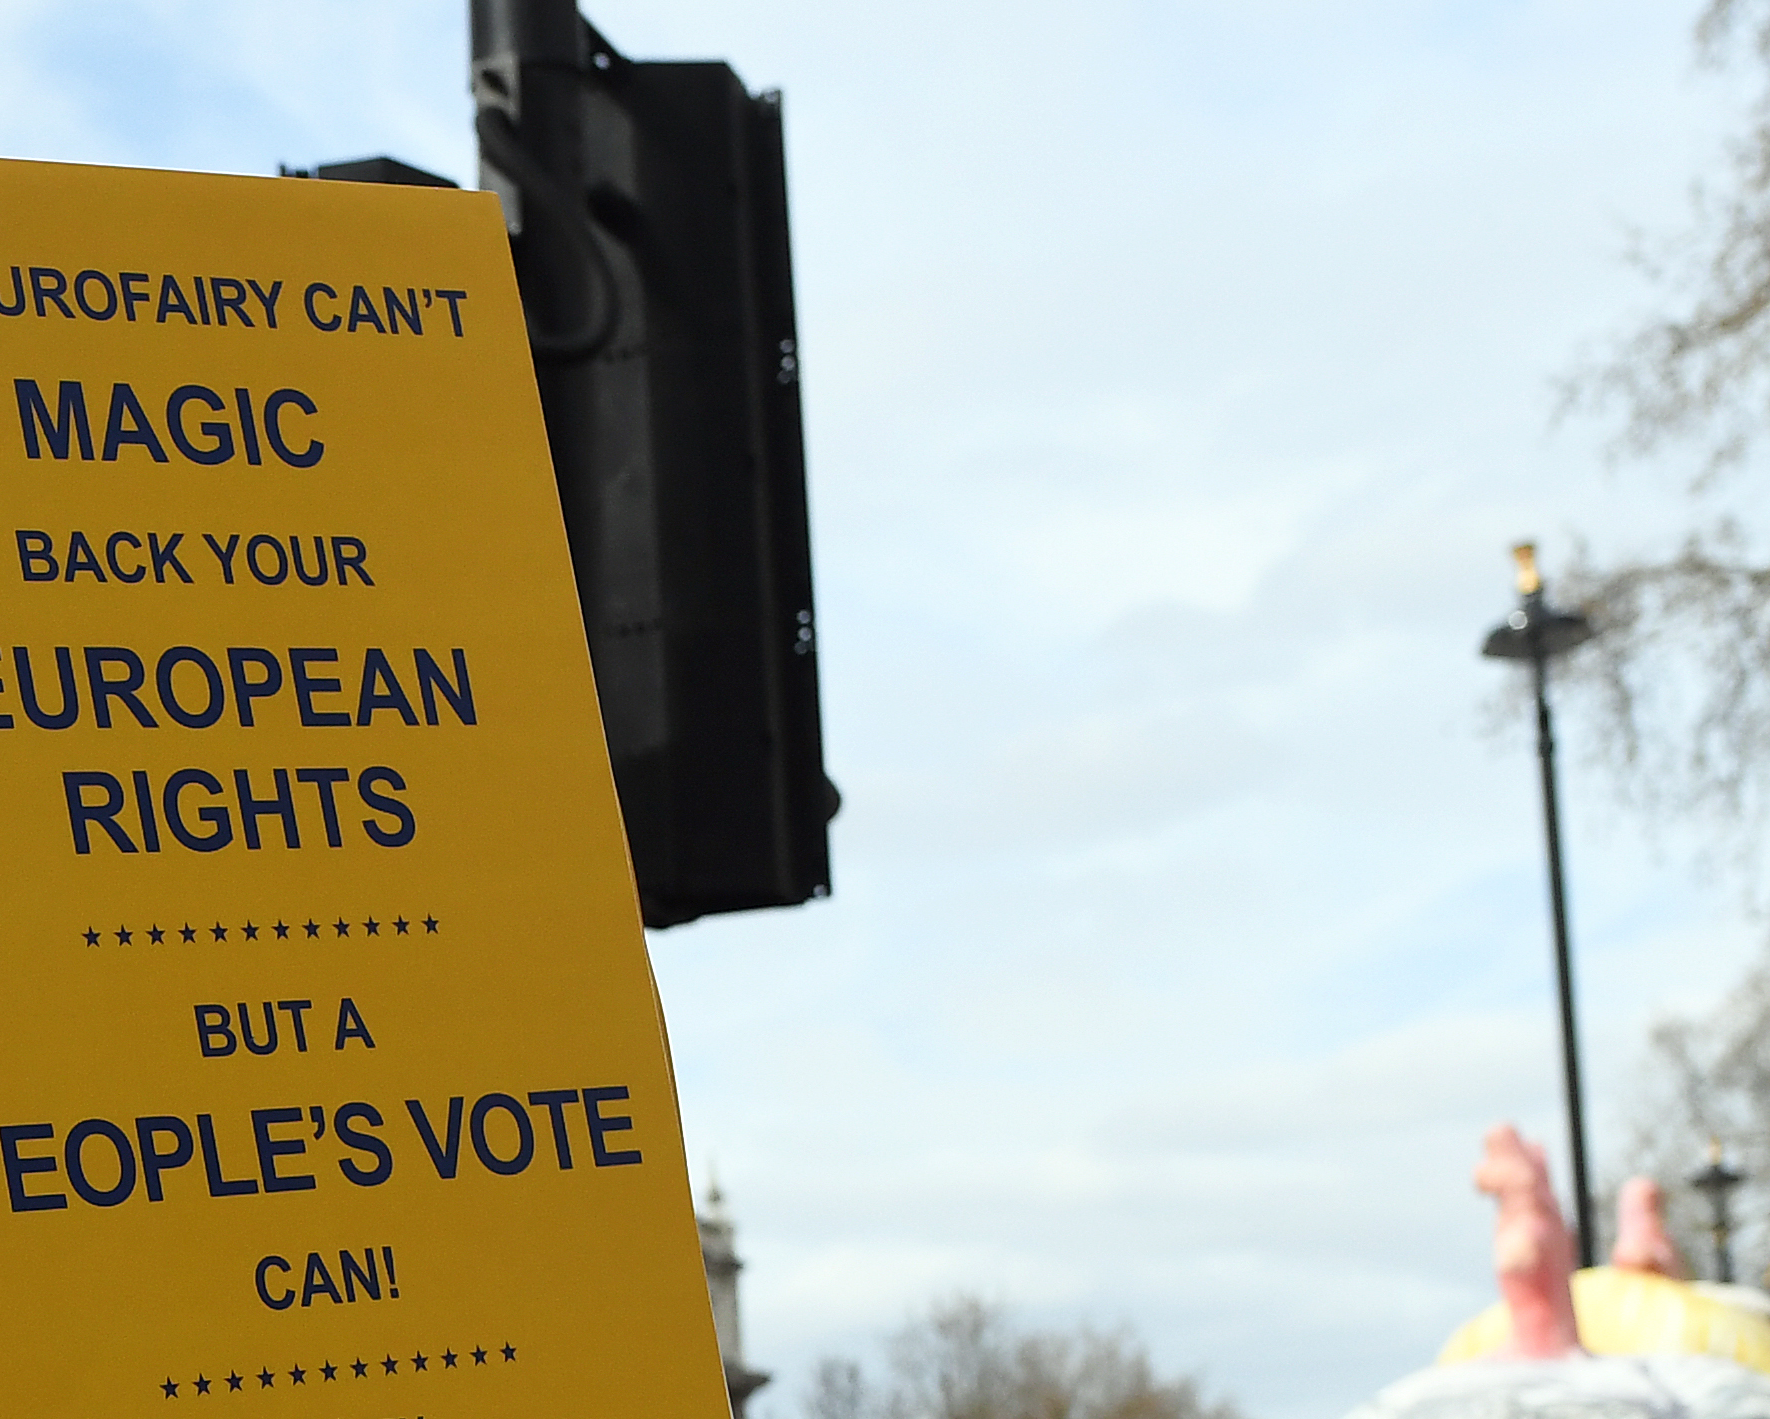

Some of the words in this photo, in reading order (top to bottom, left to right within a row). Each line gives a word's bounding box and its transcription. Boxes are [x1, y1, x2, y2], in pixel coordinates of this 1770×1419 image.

[304, 282, 467, 337] CAN’T
[14, 378, 325, 468] MAGIC
[15, 530, 193, 584] BACK
[203, 534, 374, 586] YOUR
[62, 766, 416, 855] RIGHTS
[194, 1000, 312, 1058] BUT
[335, 998, 375, 1050] A
[405, 1085, 643, 1179] VOTE
[255, 1246, 400, 1311] CAN!
